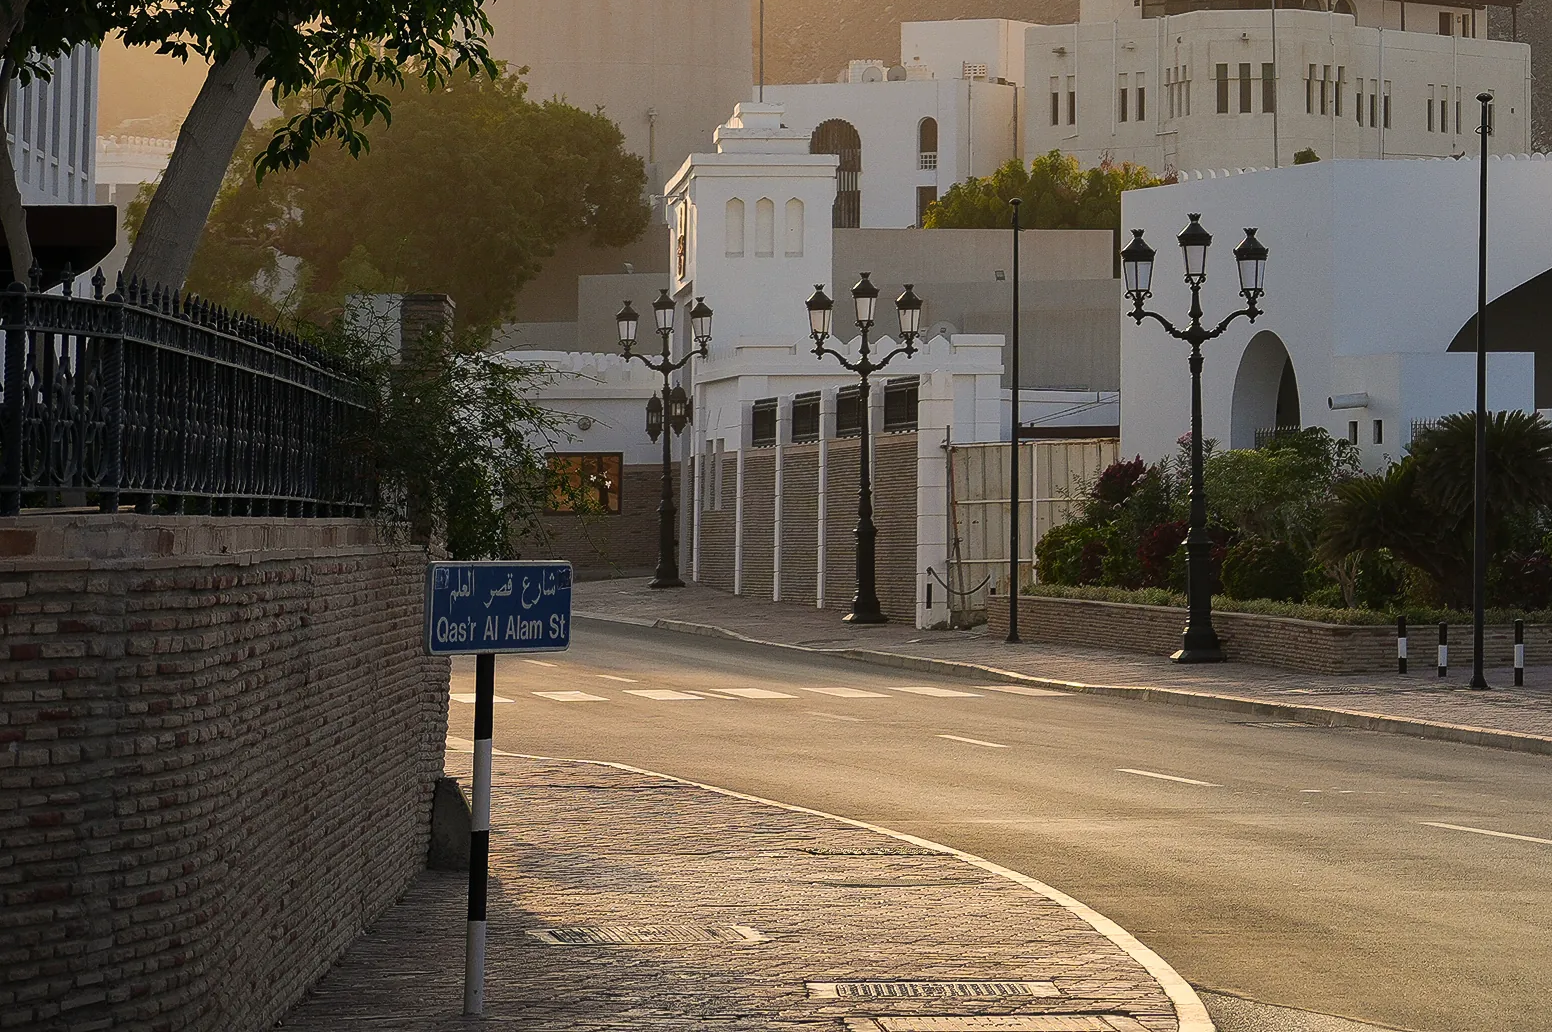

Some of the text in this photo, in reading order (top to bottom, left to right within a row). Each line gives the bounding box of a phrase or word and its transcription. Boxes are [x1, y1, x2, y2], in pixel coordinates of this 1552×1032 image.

[450, 568, 556, 614] شارع قصر العلم
[436, 613, 566, 643] Qas'r Al Alam St
